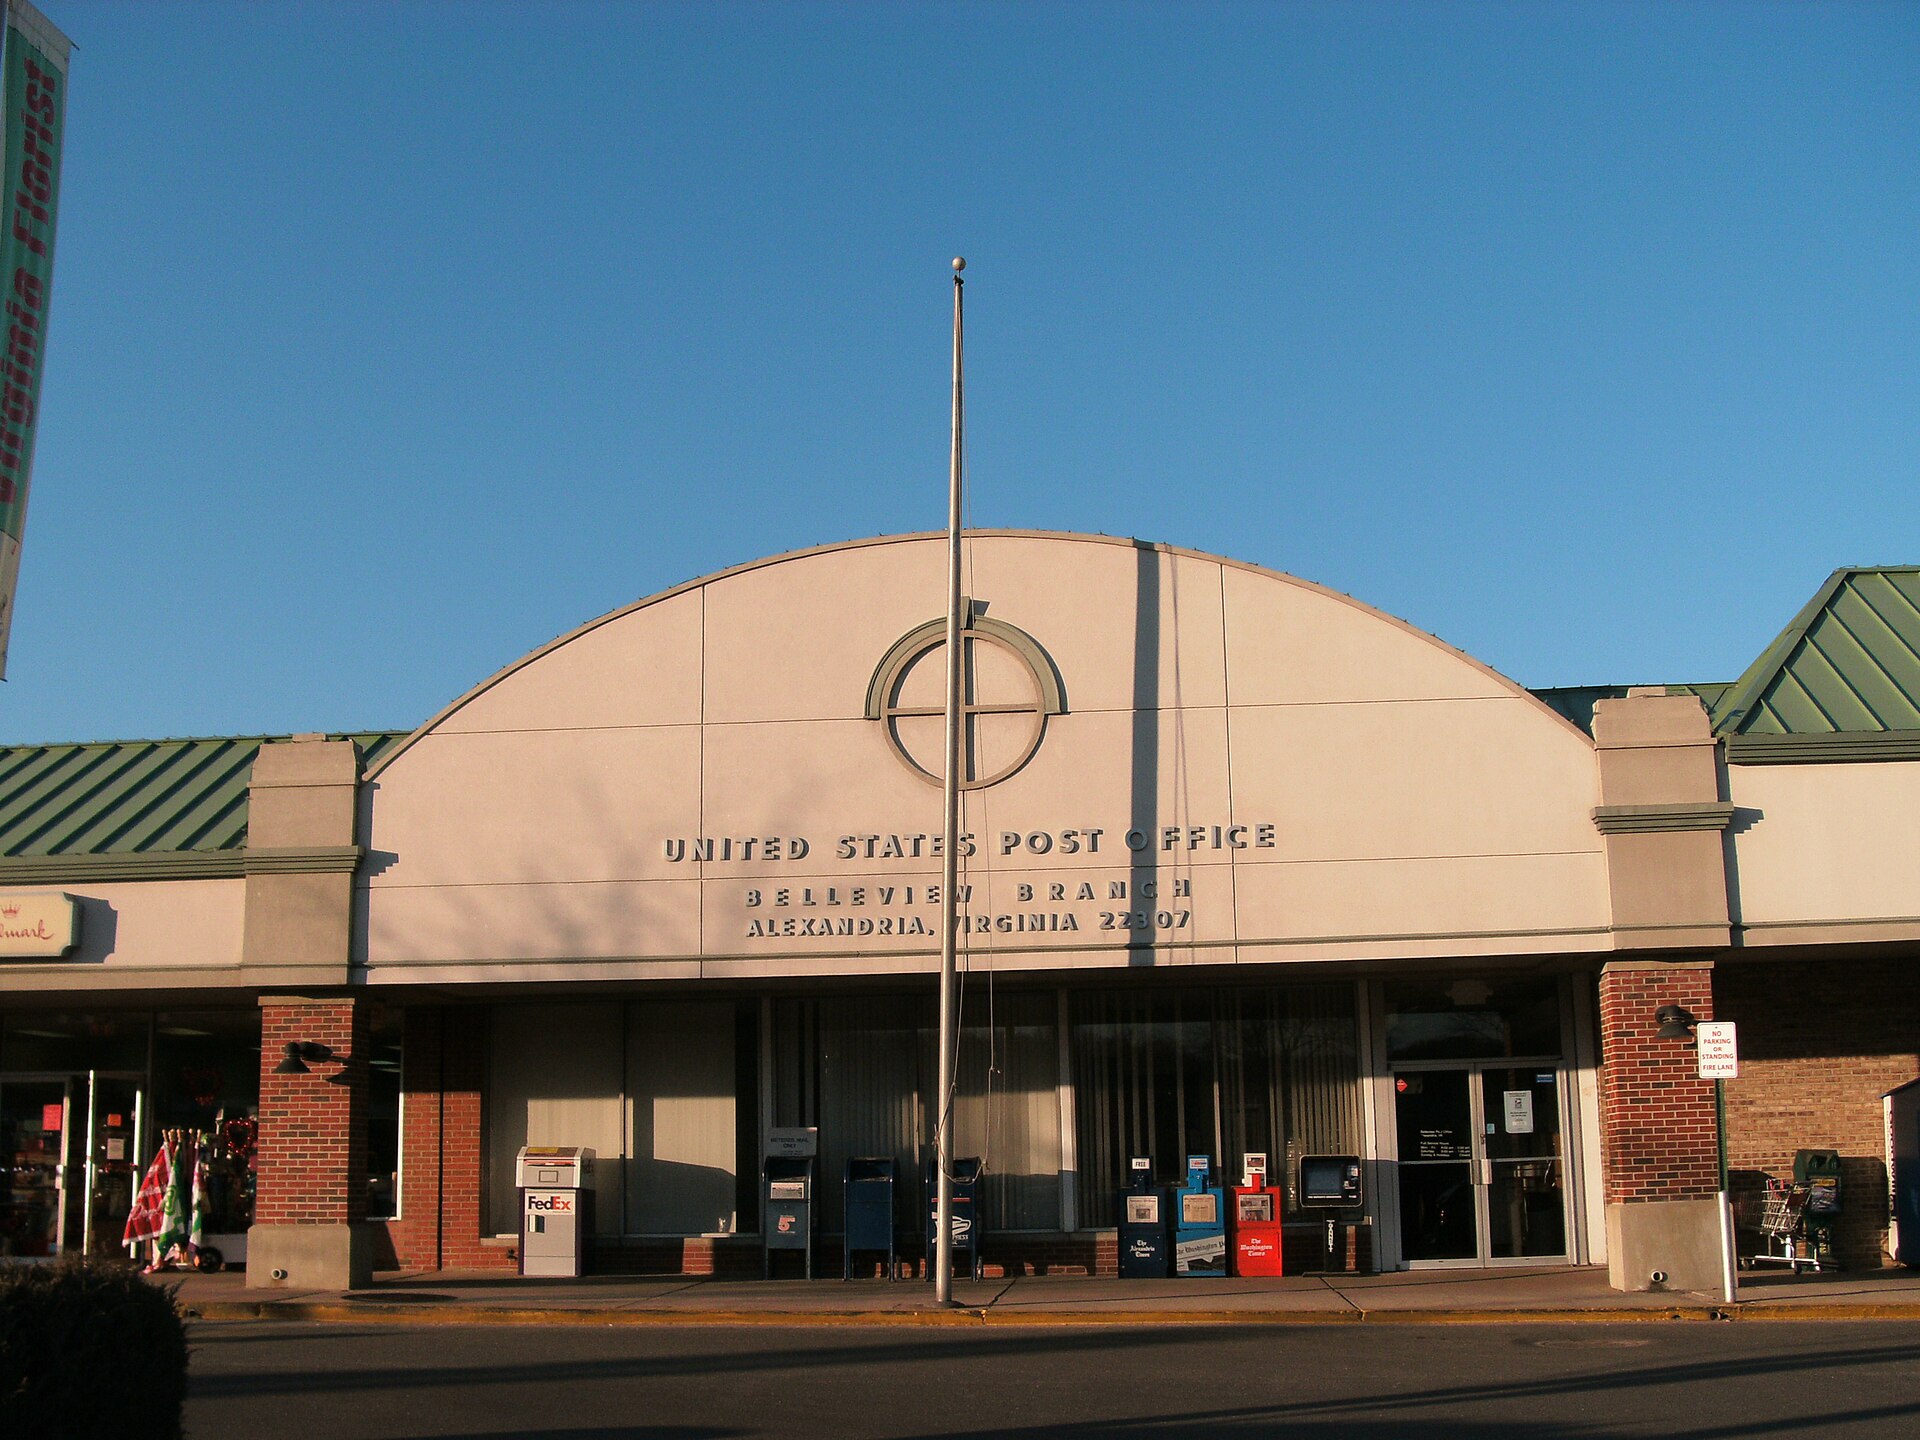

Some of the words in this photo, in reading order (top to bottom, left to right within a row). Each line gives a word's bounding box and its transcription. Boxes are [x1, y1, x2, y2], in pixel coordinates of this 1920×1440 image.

[13, 57, 55, 258] Florist
[664, 837, 811, 862] UNITED
[836, 832, 977, 859] STATES
[1000, 829, 1103, 855] POST
[1125, 824, 1276, 851] OFFICE
[1016, 879, 1191, 901] BRANCH
[746, 916, 935, 937] ALEXANDRIA,
[1099, 910, 1191, 930] 22307
[528, 1196, 571, 1211] FedEx
